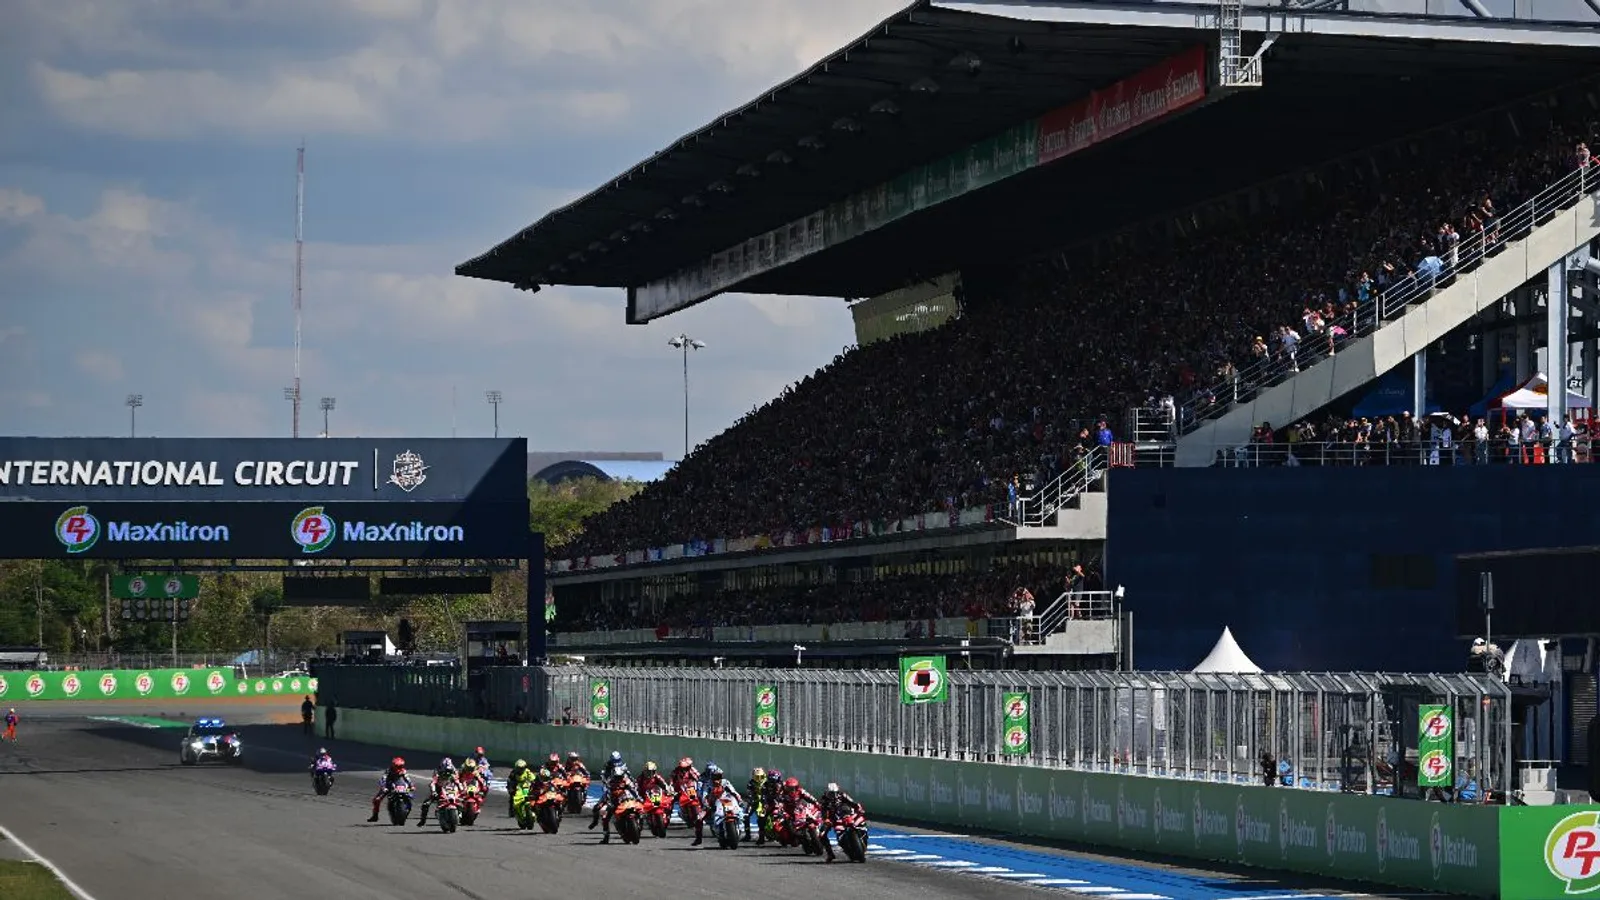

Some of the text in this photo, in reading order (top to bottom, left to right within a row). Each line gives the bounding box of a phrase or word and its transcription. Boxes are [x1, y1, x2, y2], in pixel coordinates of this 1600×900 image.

[234, 460, 359, 486] CIRCUIT
[67, 517, 230, 543] PT Maxnitron
[302, 517, 464, 543] PT Maxnitron
[1563, 831, 1600, 875] PT
